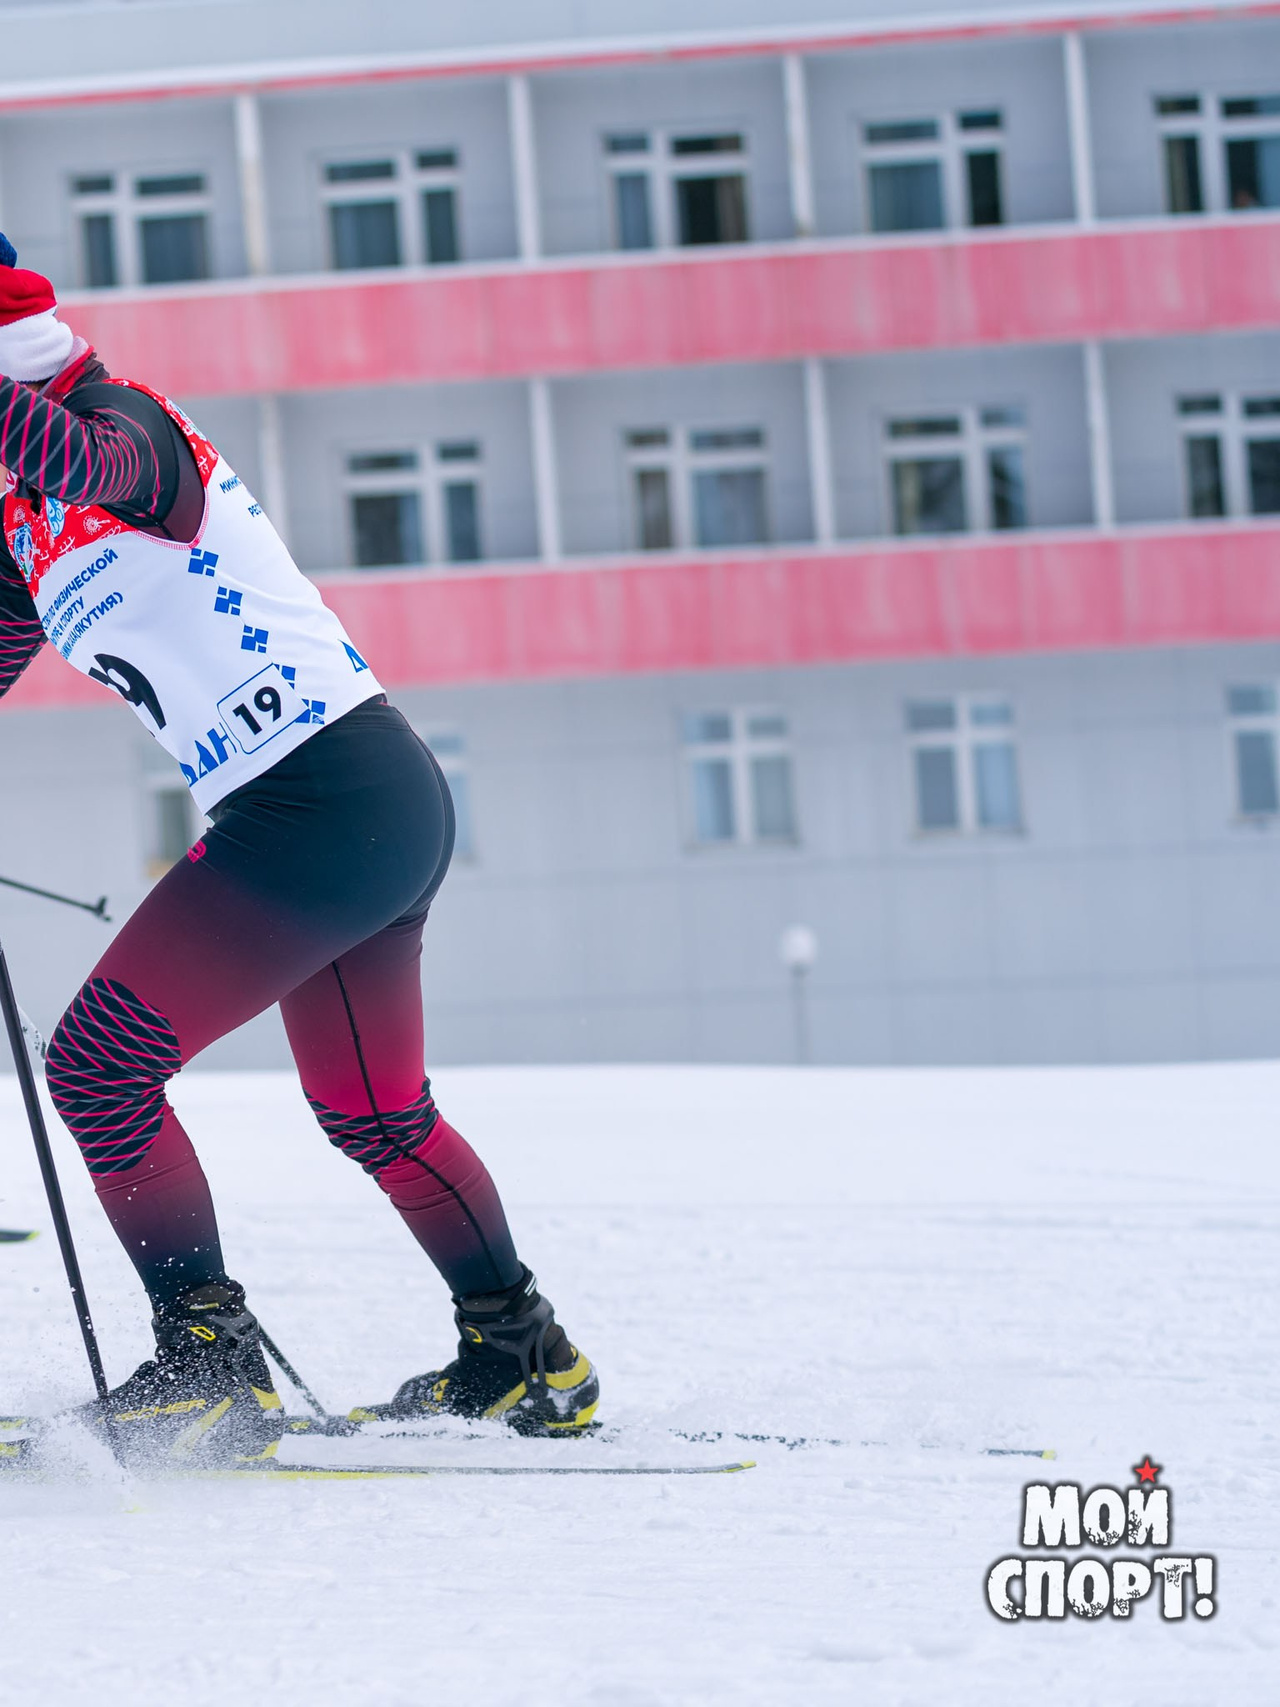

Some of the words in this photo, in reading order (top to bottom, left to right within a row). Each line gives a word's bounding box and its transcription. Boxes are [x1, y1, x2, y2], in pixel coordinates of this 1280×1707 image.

[53, 548, 119, 611] ФИЗИЧЕСКОЙ
[60, 595, 84, 628] СПОРТУ
[231, 685, 282, 736] 19
